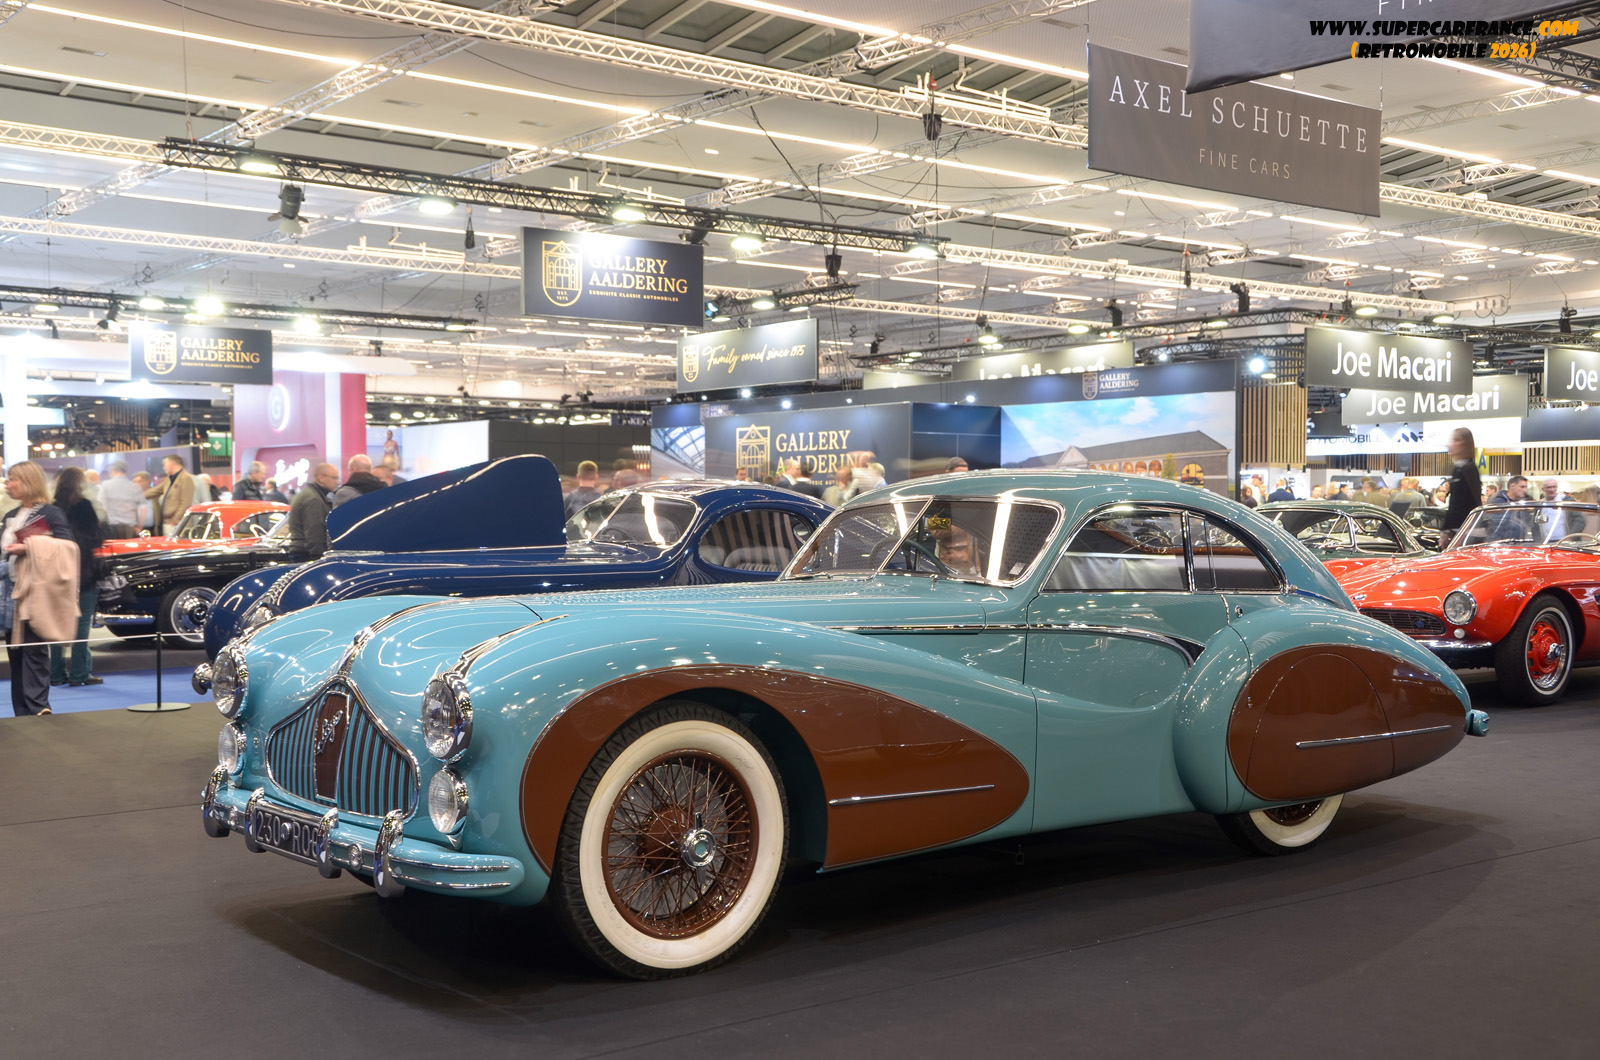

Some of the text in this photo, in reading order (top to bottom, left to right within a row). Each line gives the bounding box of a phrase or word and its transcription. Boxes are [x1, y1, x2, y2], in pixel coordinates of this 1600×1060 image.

[1109, 75, 1367, 153] AXEL SCHUETTE
[1199, 148, 1290, 179] FINE CARS
[588, 254, 668, 275] GALLERY
[588, 271, 688, 294] AALDERING
[180, 337, 244, 351] GALLERY
[180, 349, 260, 363] AALDERING
[702, 344, 740, 374] Family
[741, 344, 768, 363] owned
[766, 348, 791, 361] since
[1331, 342, 1452, 383] Joe Macari
[1099, 372, 1131, 382] GALLERY
[1099, 379, 1139, 390] AALDERING
[1566, 361, 1598, 391] Joe
[1366, 385, 1500, 416] Joe Macari
[775, 430, 851, 452] GALLERY
[257, 810, 280, 847] 230
